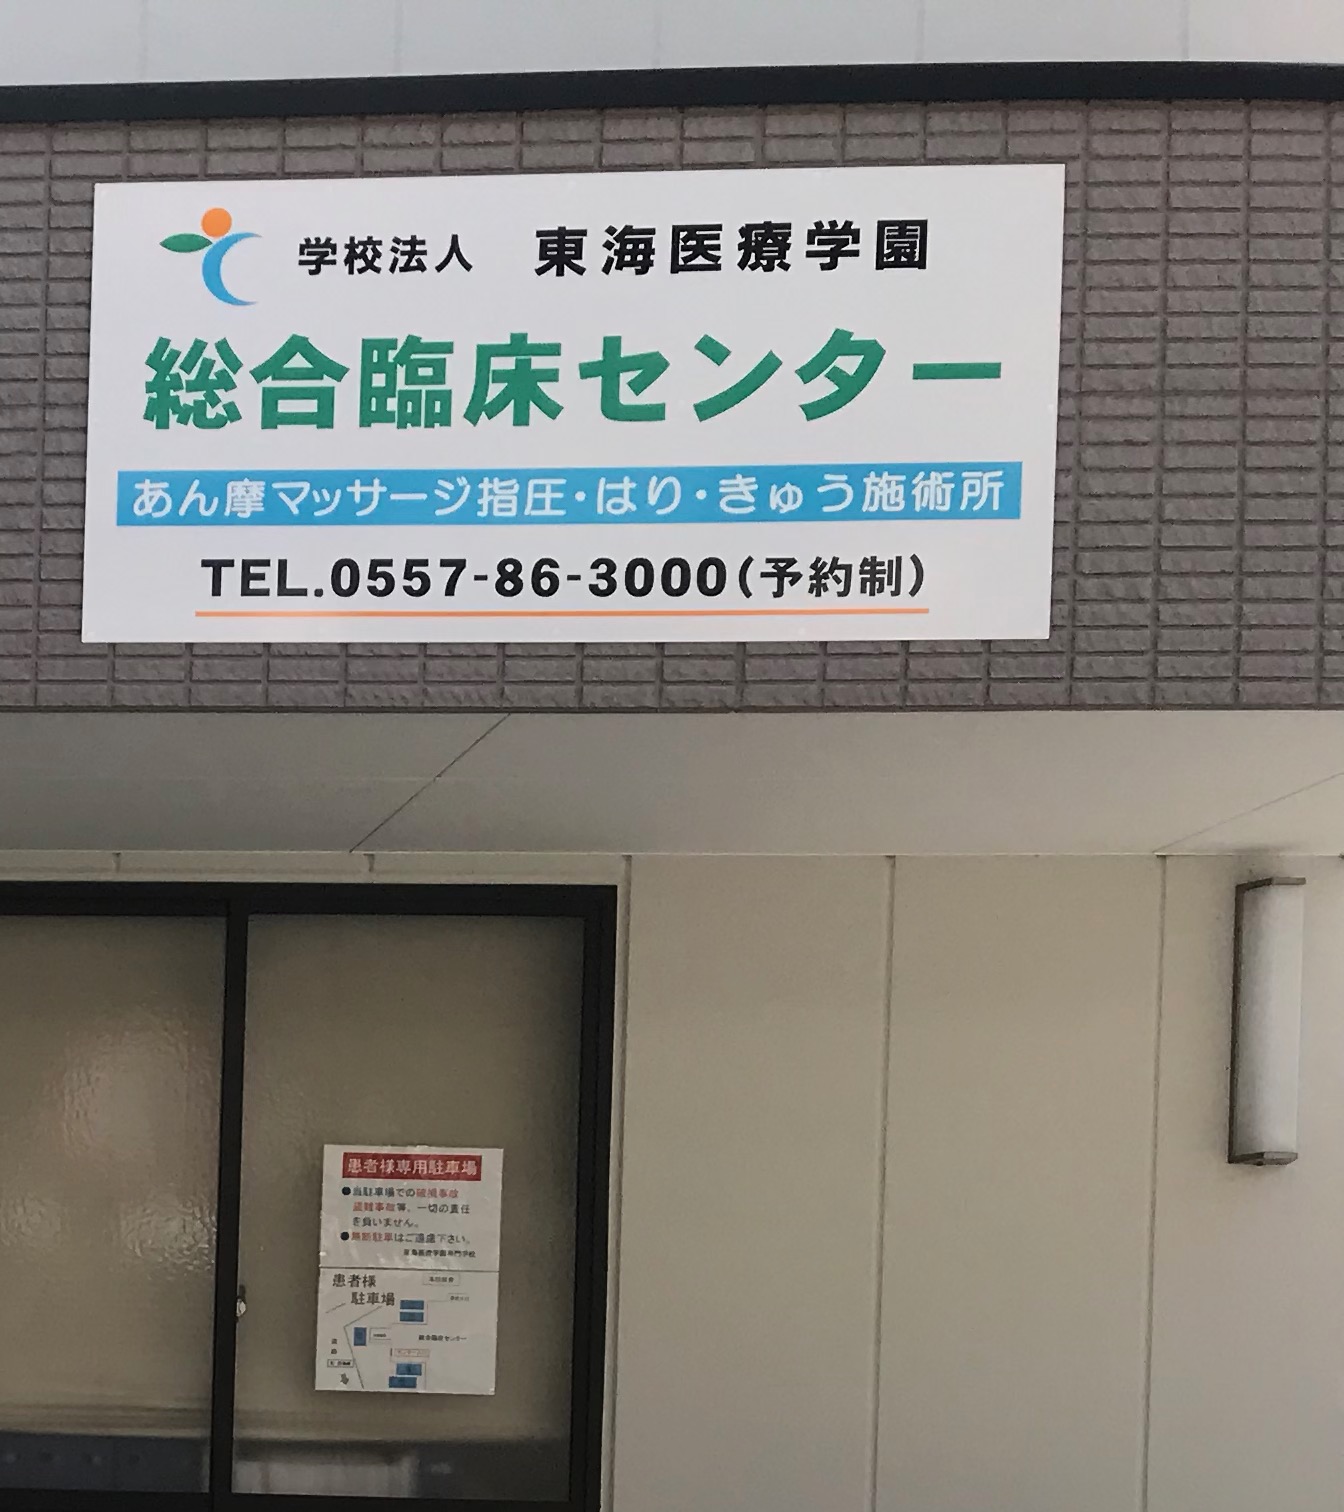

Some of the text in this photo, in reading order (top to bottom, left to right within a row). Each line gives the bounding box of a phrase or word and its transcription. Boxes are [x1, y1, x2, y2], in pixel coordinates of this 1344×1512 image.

[297, 218, 930, 278] 学校法人 東海医療学園
[143, 328, 1003, 433] 総合臨床センター
[132, 470, 1005, 518] あん摩マッサージ指圧・はり・きゅう施術所
[201, 553, 926, 599] TEL.0557-86-3000(予約制)
[347, 1157, 478, 1176] 患者様専用駐車場
[332, 1273, 377, 1289] 患者様
[350, 1291, 395, 1307] 駐車場
